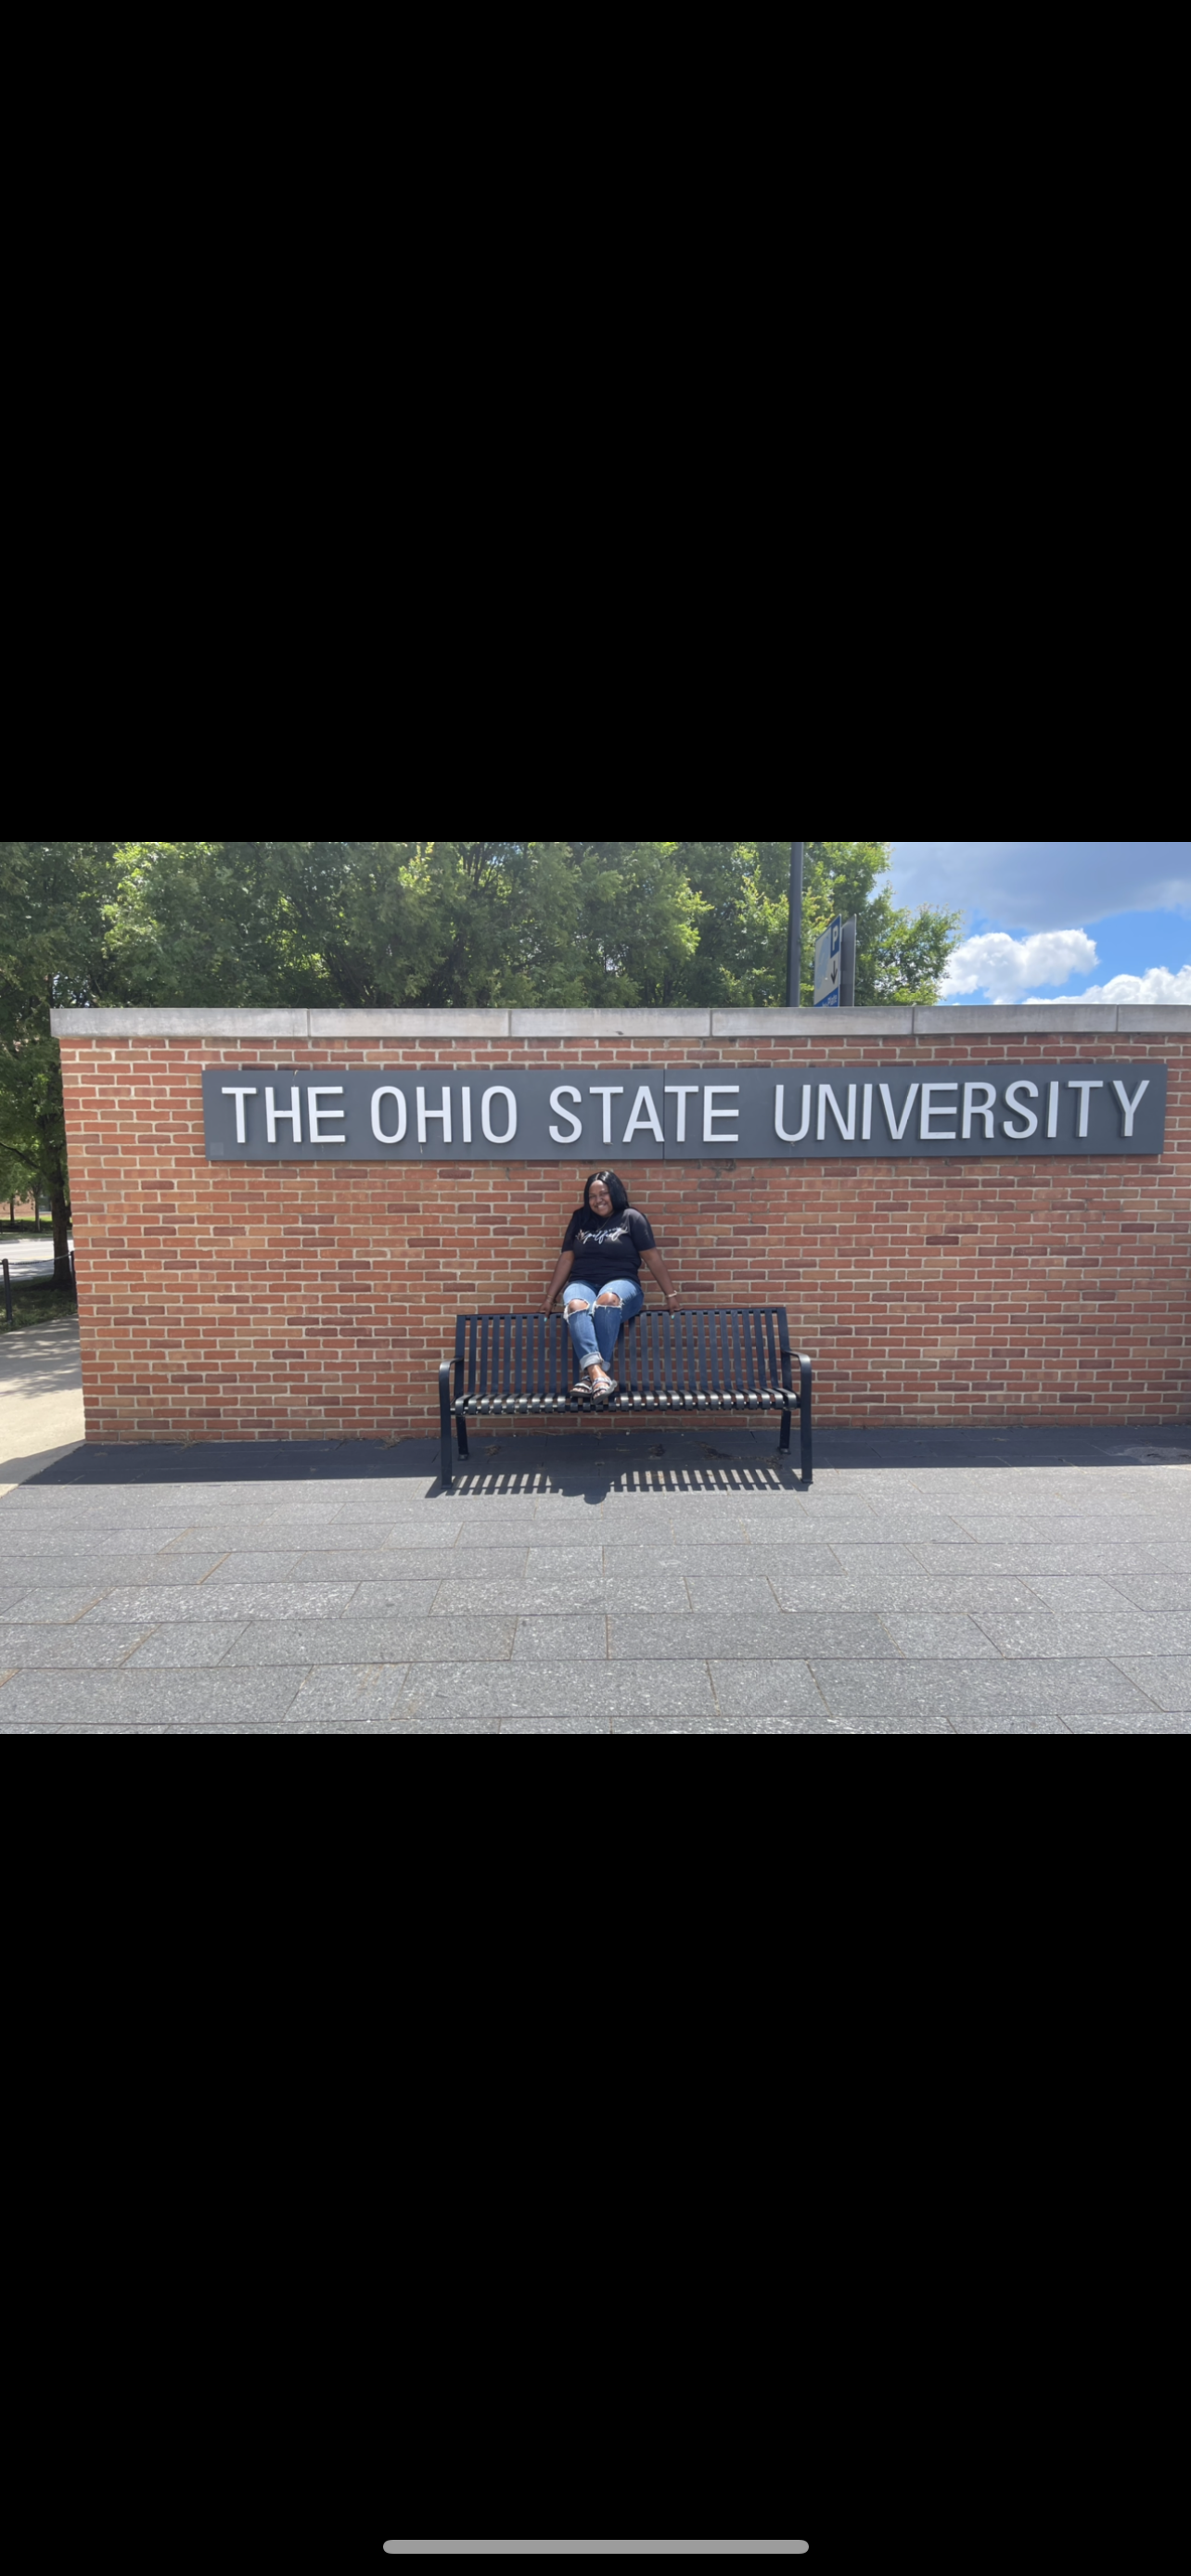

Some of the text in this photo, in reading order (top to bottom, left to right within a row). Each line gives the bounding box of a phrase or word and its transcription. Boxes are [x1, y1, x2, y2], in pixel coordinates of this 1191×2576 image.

[832, 925, 839, 951] P
[221, 1080, 1149, 1144] THE OHIO STATE UNIVERSITY
